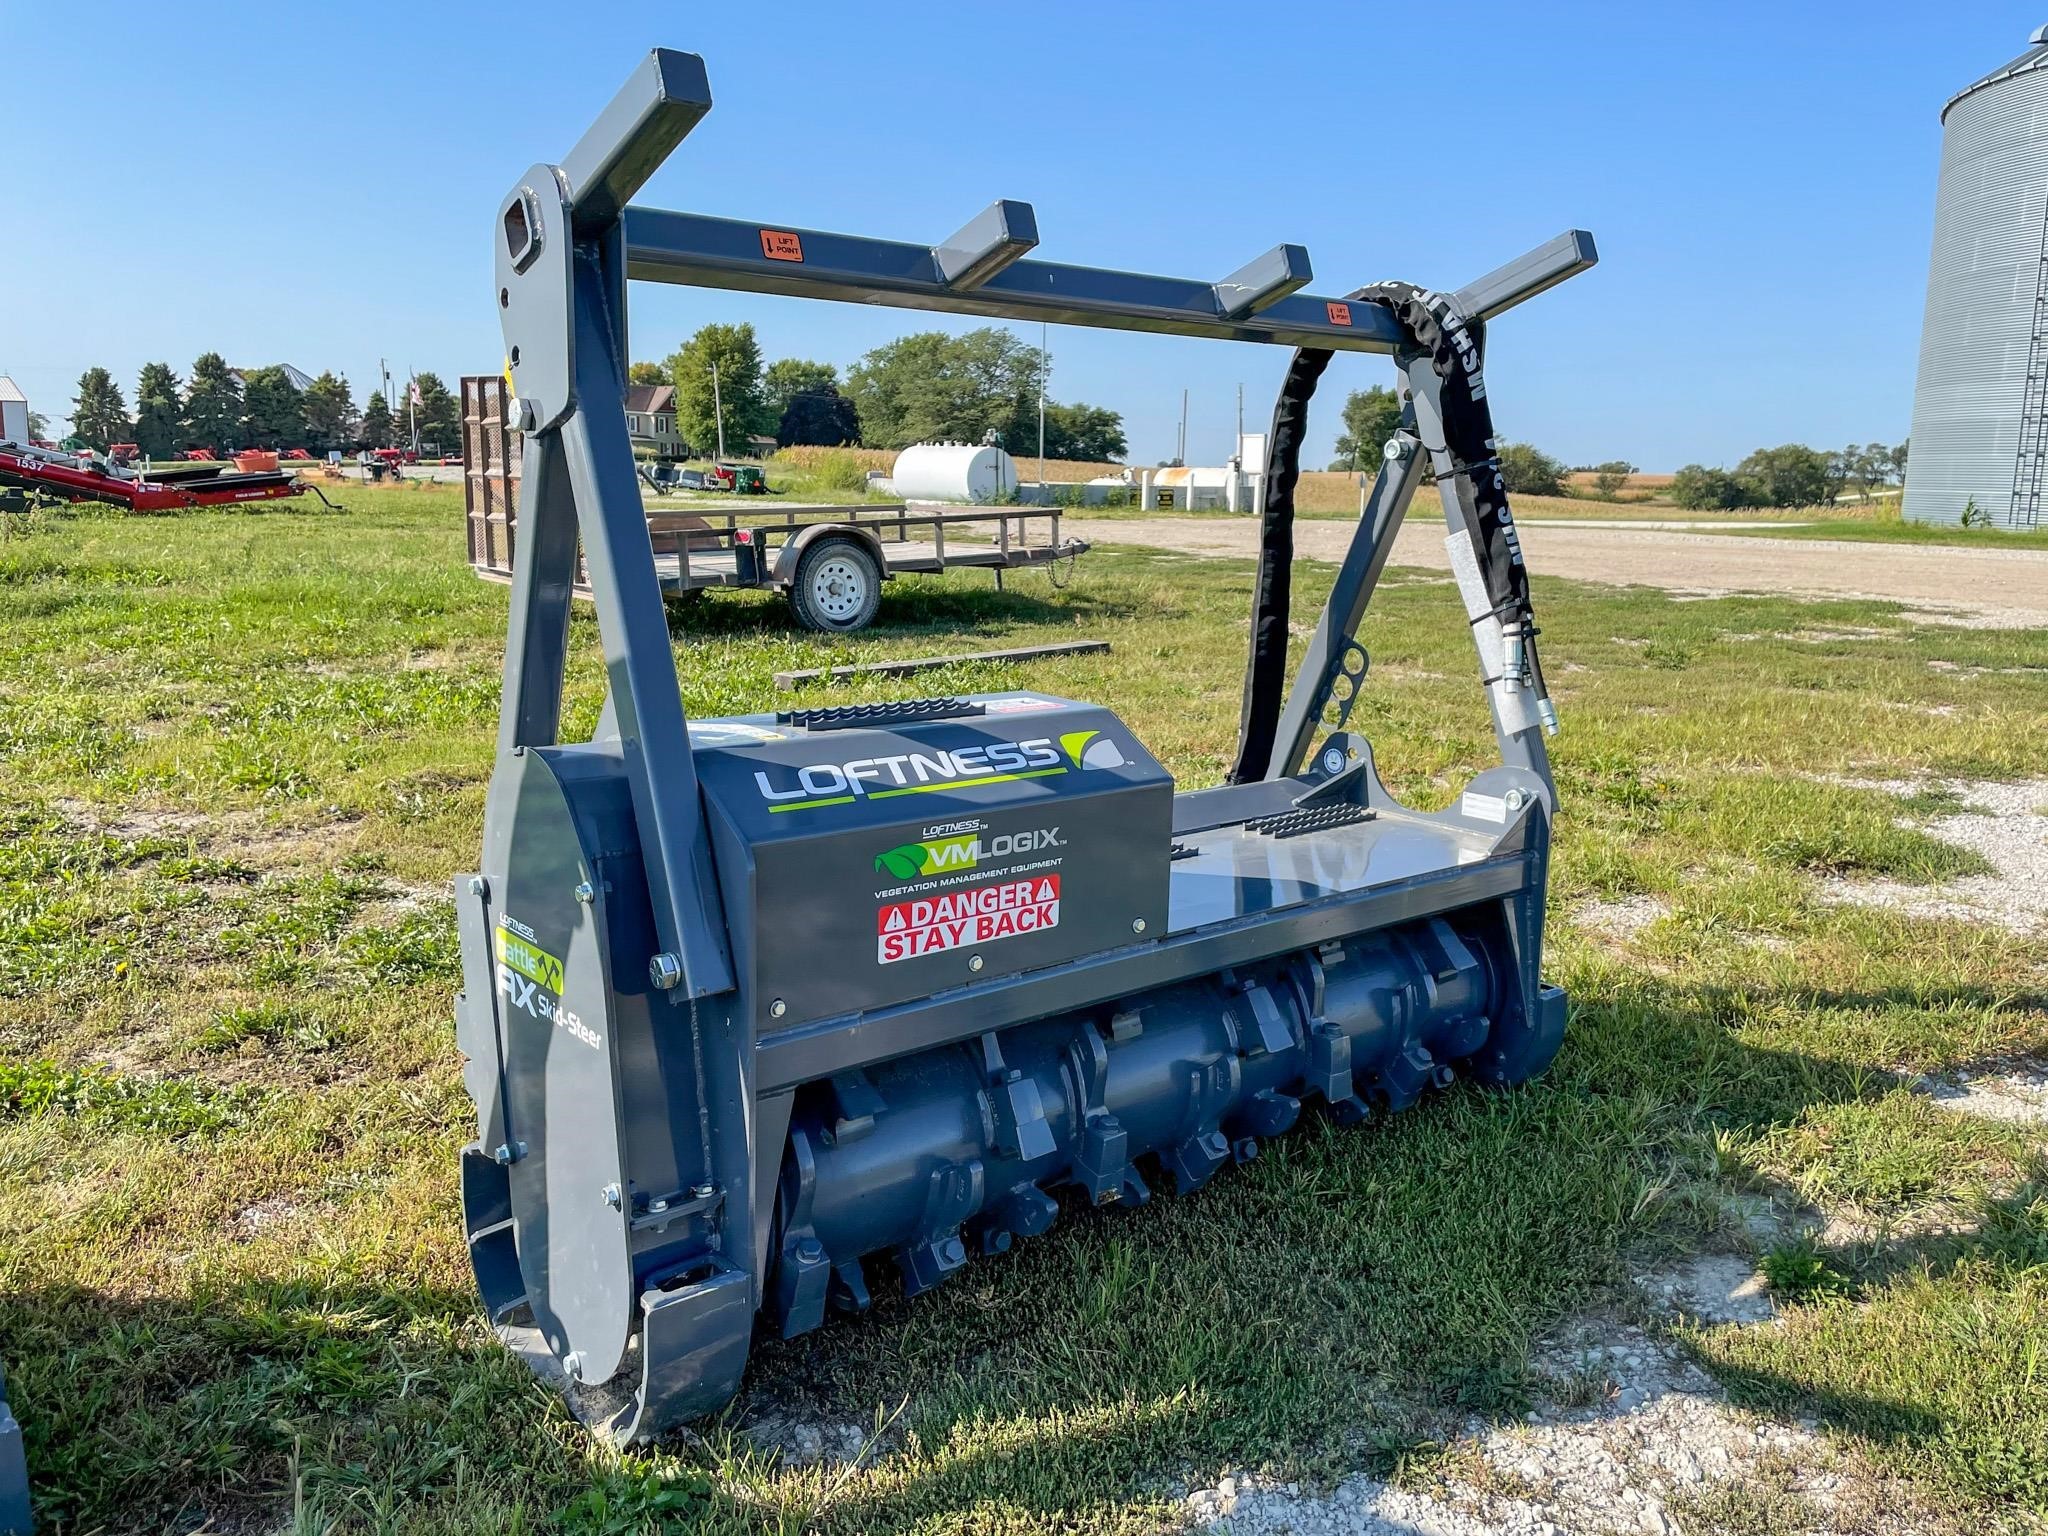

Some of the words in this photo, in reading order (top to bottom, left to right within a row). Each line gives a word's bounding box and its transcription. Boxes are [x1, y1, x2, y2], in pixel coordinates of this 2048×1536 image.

[776, 246, 798, 254] POINT
[15, 458, 44, 472] 1537
[754, 738, 1061, 800] LOFTNESS
[922, 819, 980, 836] LOFTNESS
[875, 880, 937, 899] VEGETATION
[940, 868, 1009, 887] MANAGEMENT
[1010, 857, 1063, 874] EQUIPMENT
[911, 881, 1033, 928] DANGER
[884, 920, 969, 960] STAY
[976, 903, 1055, 941] BACK
[499, 937, 537, 976] attle
[537, 993, 602, 1050] Skid-Steer
